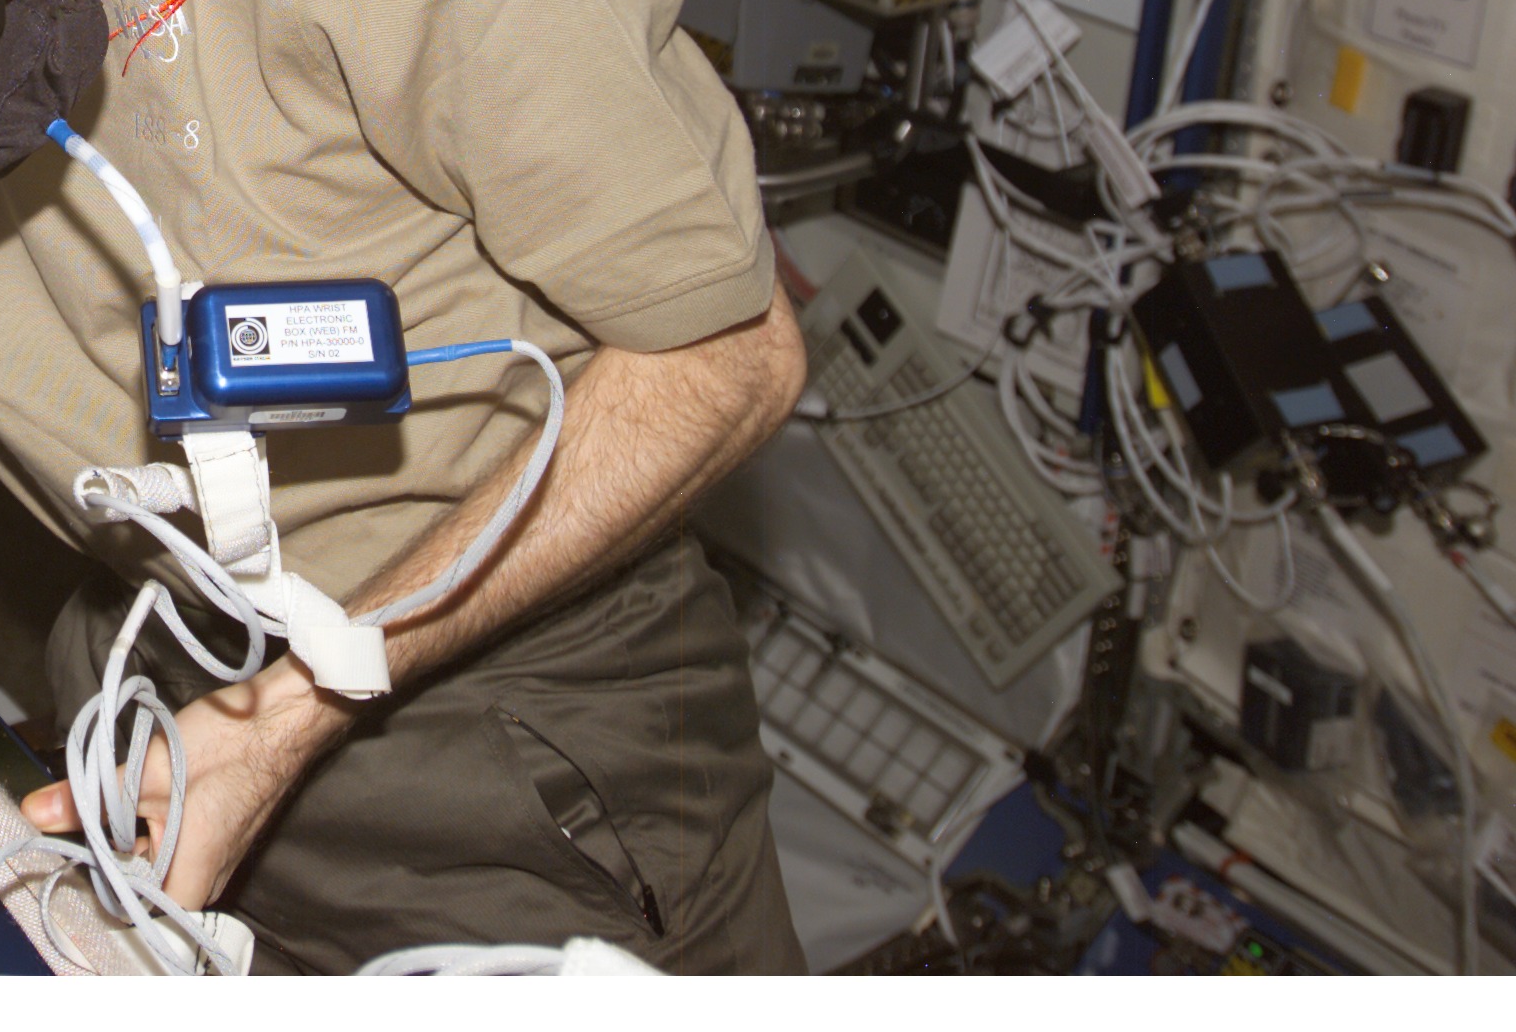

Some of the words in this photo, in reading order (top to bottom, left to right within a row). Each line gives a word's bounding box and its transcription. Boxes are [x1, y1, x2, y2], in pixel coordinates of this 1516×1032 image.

[289, 304, 311, 313] HPA
[313, 303, 346, 313] WRIST
[286, 314, 354, 325] ELECTRONIC
[284, 328, 307, 337] BOX
[309, 326, 340, 336] (WEB)
[343, 326, 358, 334] FM
[280, 338, 299, 348] P/N
[308, 349, 326, 358] S/N
